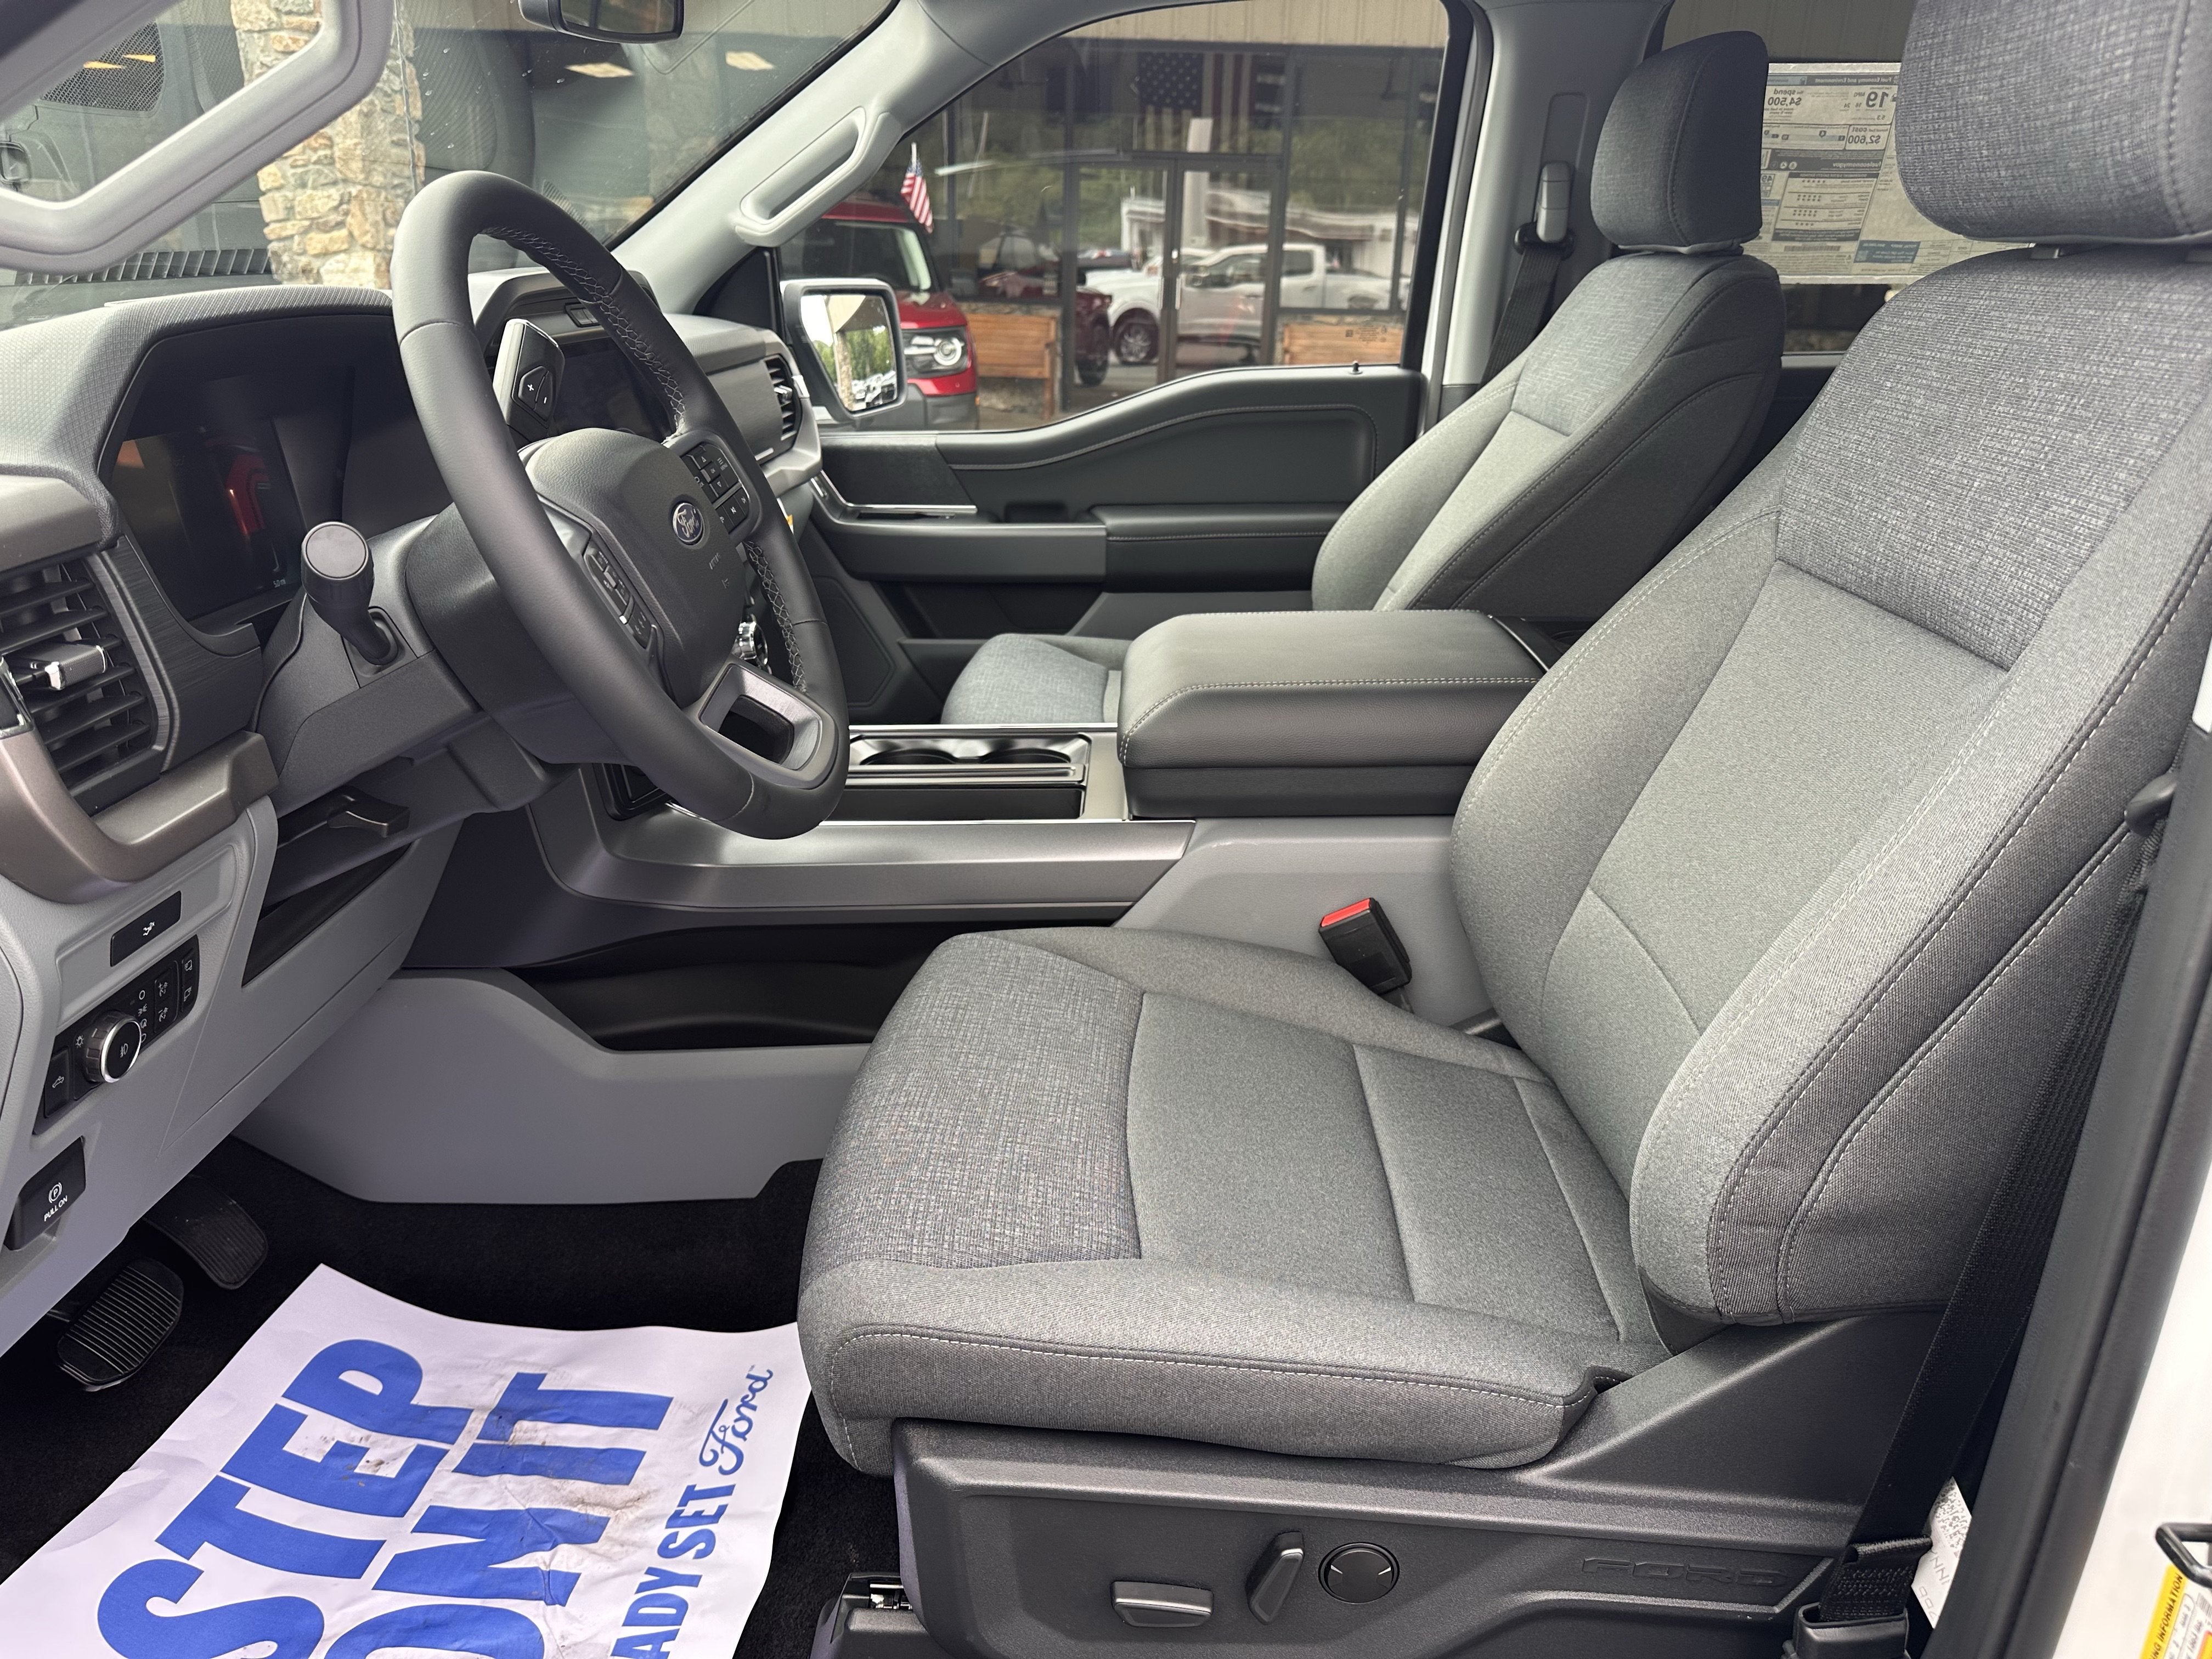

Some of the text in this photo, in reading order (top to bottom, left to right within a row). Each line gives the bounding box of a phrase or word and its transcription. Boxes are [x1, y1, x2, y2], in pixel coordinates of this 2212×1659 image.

[677, 508, 701, 539] Ford
[44, 1195, 68, 1221] PULL ON
[657, 1483, 736, 1560] SET
[698, 1365, 774, 1476] Ford
[97, 1338, 476, 1659] STEP
[1582, 1557, 1790, 1587] FORD
[2157, 1573, 2183, 1643] INFORMATION
